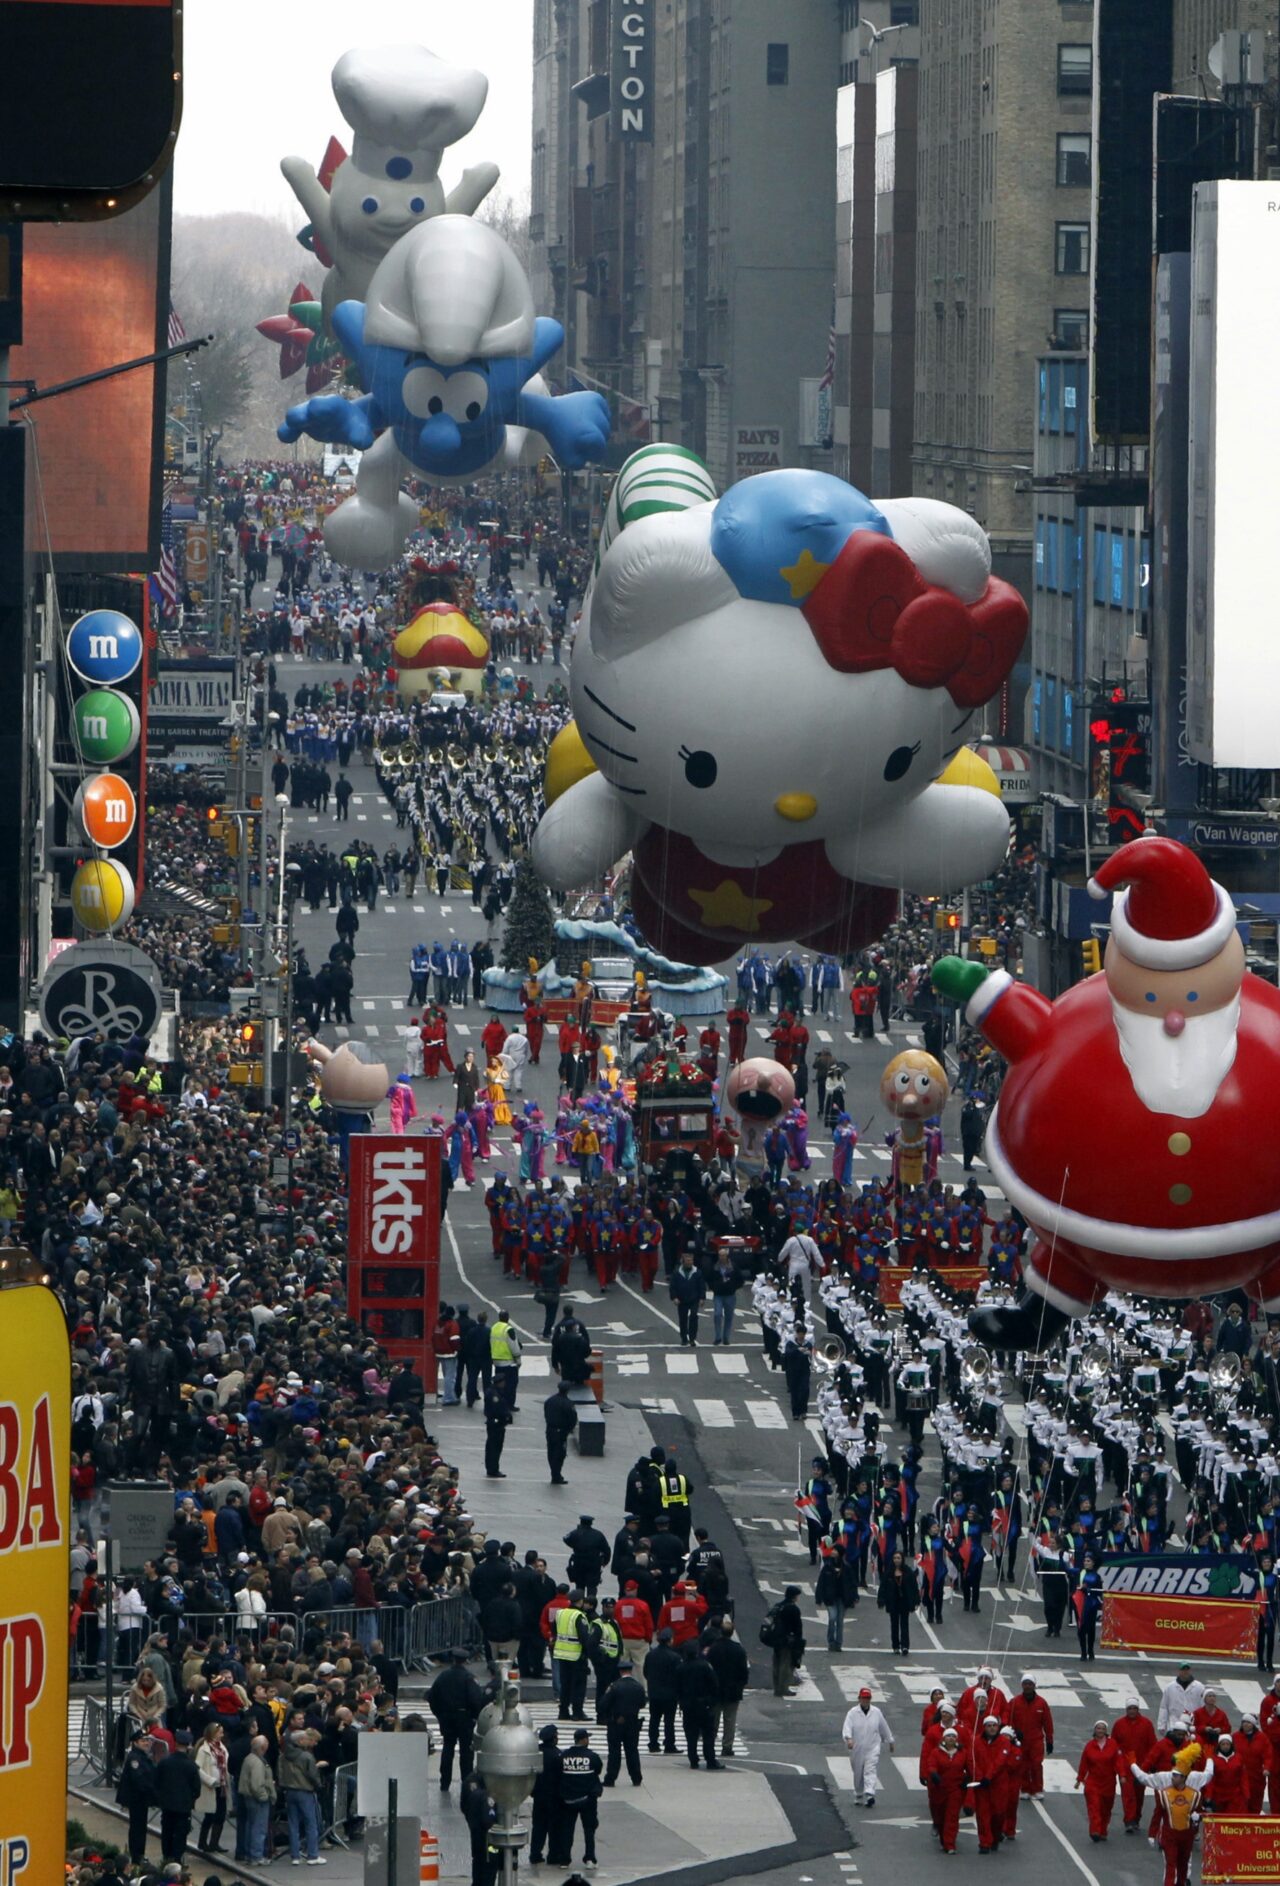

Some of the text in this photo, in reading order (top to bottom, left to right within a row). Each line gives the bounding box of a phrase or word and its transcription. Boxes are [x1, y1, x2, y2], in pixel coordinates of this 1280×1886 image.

[621, 0, 645, 131] GTON
[738, 430, 779, 445] RAY'S
[736, 452, 780, 466] PIZZA
[90, 634, 119, 658] m
[83, 716, 107, 739] m
[168, 728, 196, 736] GARDEN
[106, 799, 127, 822] m
[1204, 826, 1279, 844] Van Wagner
[371, 1147, 426, 1255] tkts
[1096, 1566, 1255, 1595] HARRISN
[1154, 1619, 1204, 1631] GEORGIA
[563, 1758, 590, 1766] NYPD
[1221, 1826, 1251, 1837] Macy's
[1256, 1852, 1272, 1860] BIG
[1237, 1863, 1280, 1872] Universal
